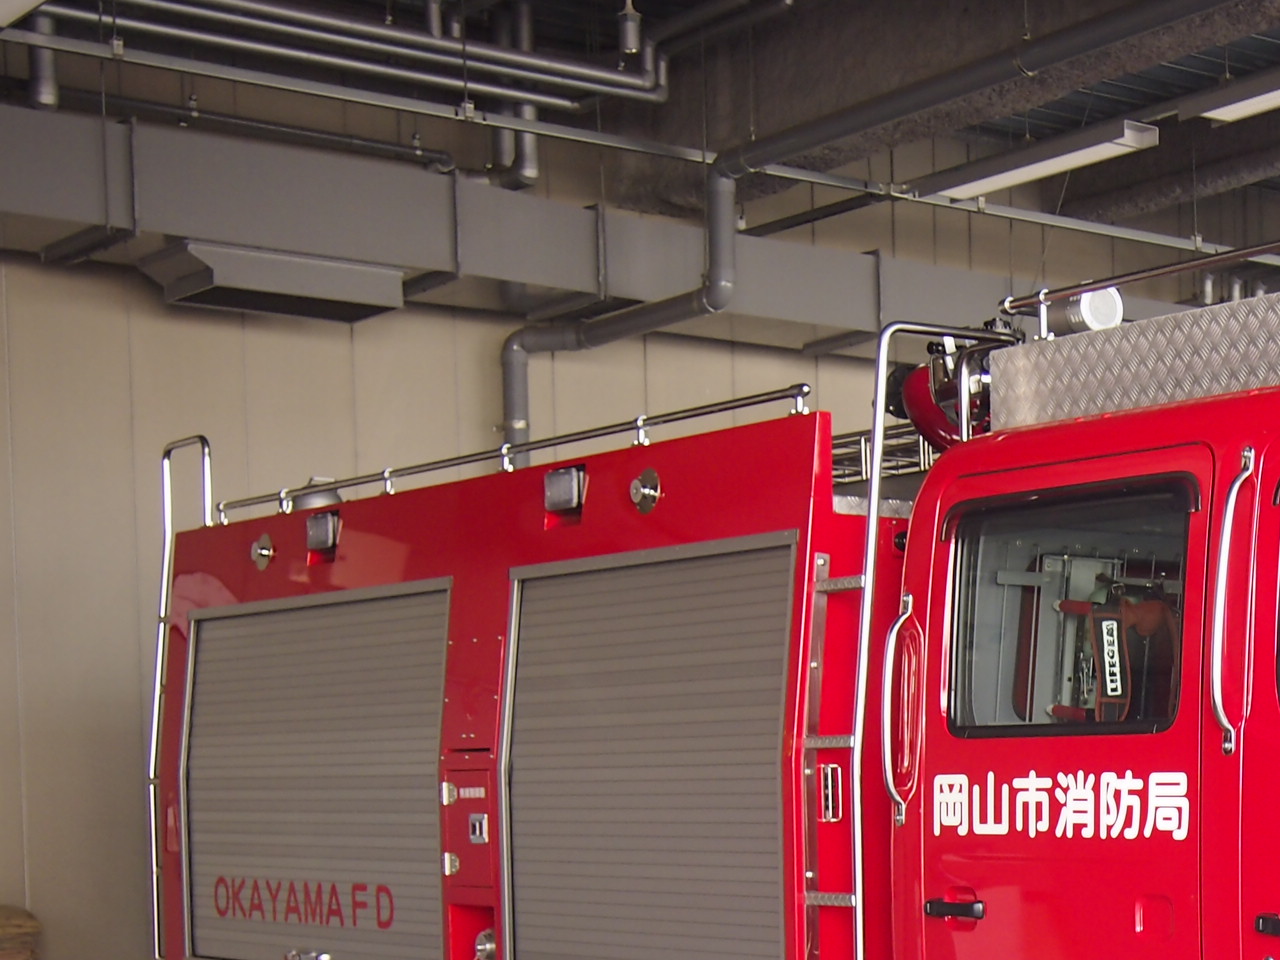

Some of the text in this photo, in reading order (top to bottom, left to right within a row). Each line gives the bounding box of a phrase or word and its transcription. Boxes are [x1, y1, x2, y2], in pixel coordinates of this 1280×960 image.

[933, 770, 1190, 841] 岡山市消防局
[213, 876, 344, 927] OKAYAMA
